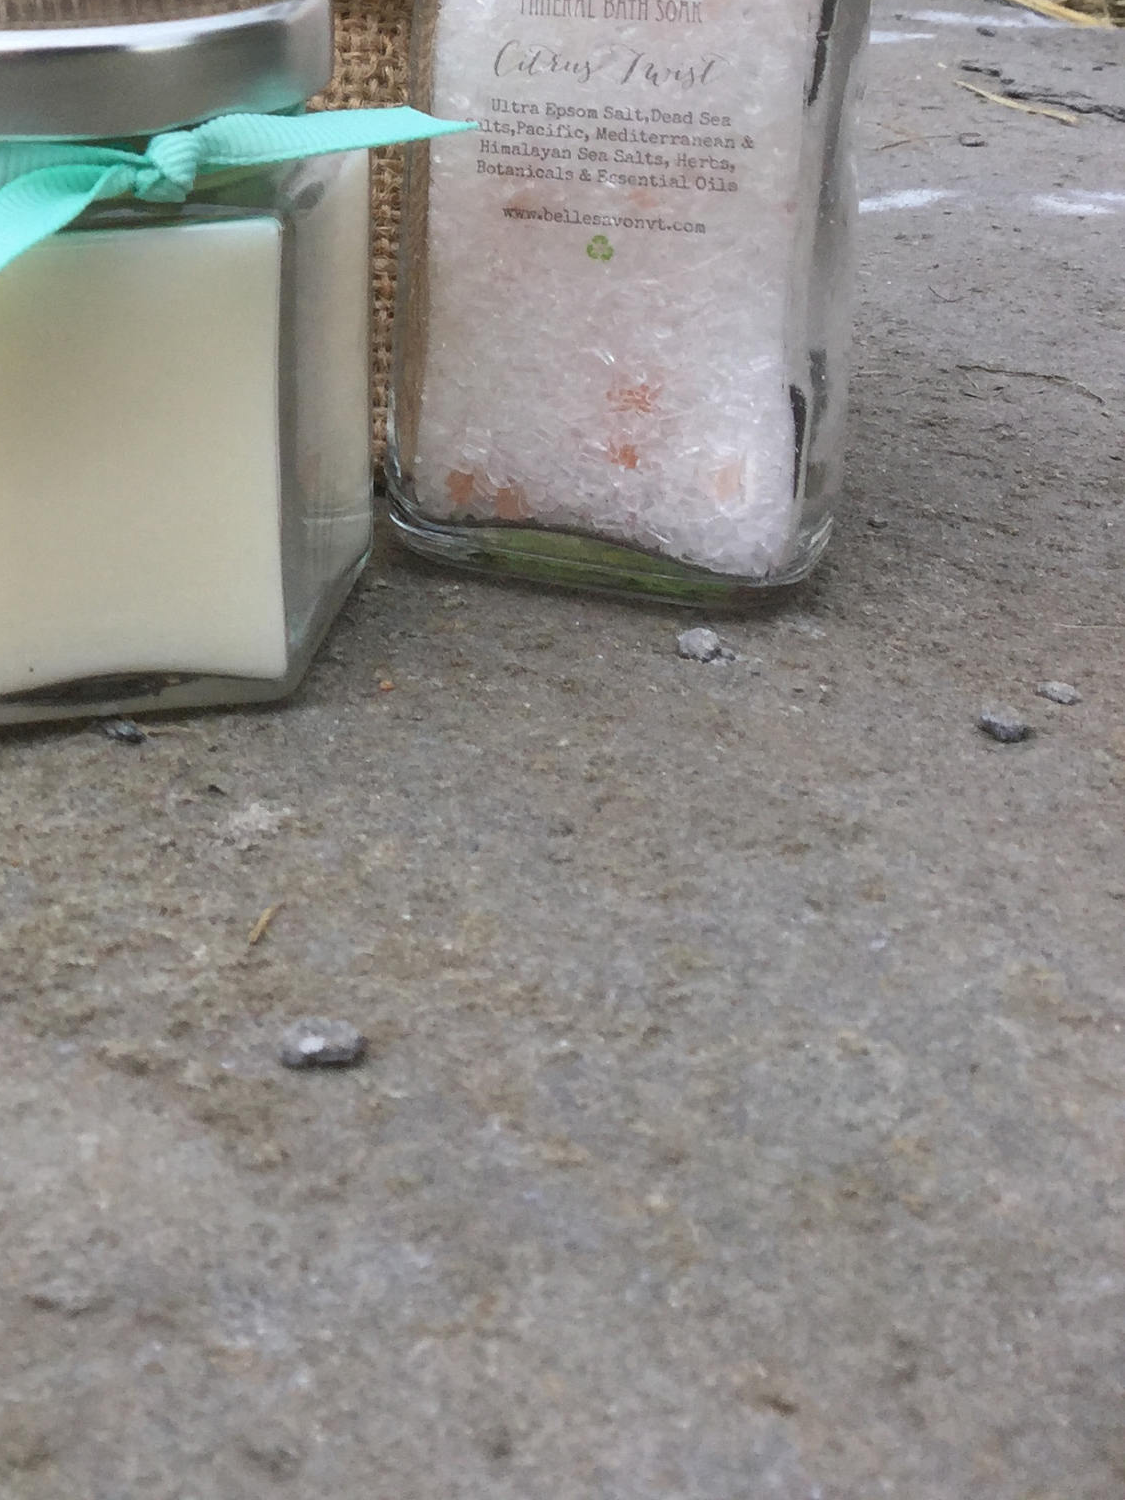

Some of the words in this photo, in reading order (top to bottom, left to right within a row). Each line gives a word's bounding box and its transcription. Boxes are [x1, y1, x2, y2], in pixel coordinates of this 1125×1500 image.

[494, 39, 597, 82] Citrus
[603, 44, 731, 87] Twist
[491, 98, 540, 115] Ultra
[545, 102, 598, 119] Epsom
[699, 111, 732, 127] Sea
[596, 127, 736, 149] Mediterranean
[741, 135, 755, 149] &
[480, 139, 572, 161] Himalayan
[578, 147, 608, 162] Sea
[613, 149, 670, 169] Salts,
[676, 153, 736, 174] Herbs,
[477, 160, 574, 181] Botanicals
[579, 168, 592, 182] &
[597, 169, 691, 190] Essential
[695, 176, 739, 193] Oils
[502, 206, 707, 235] www.bellesavonvt.com
